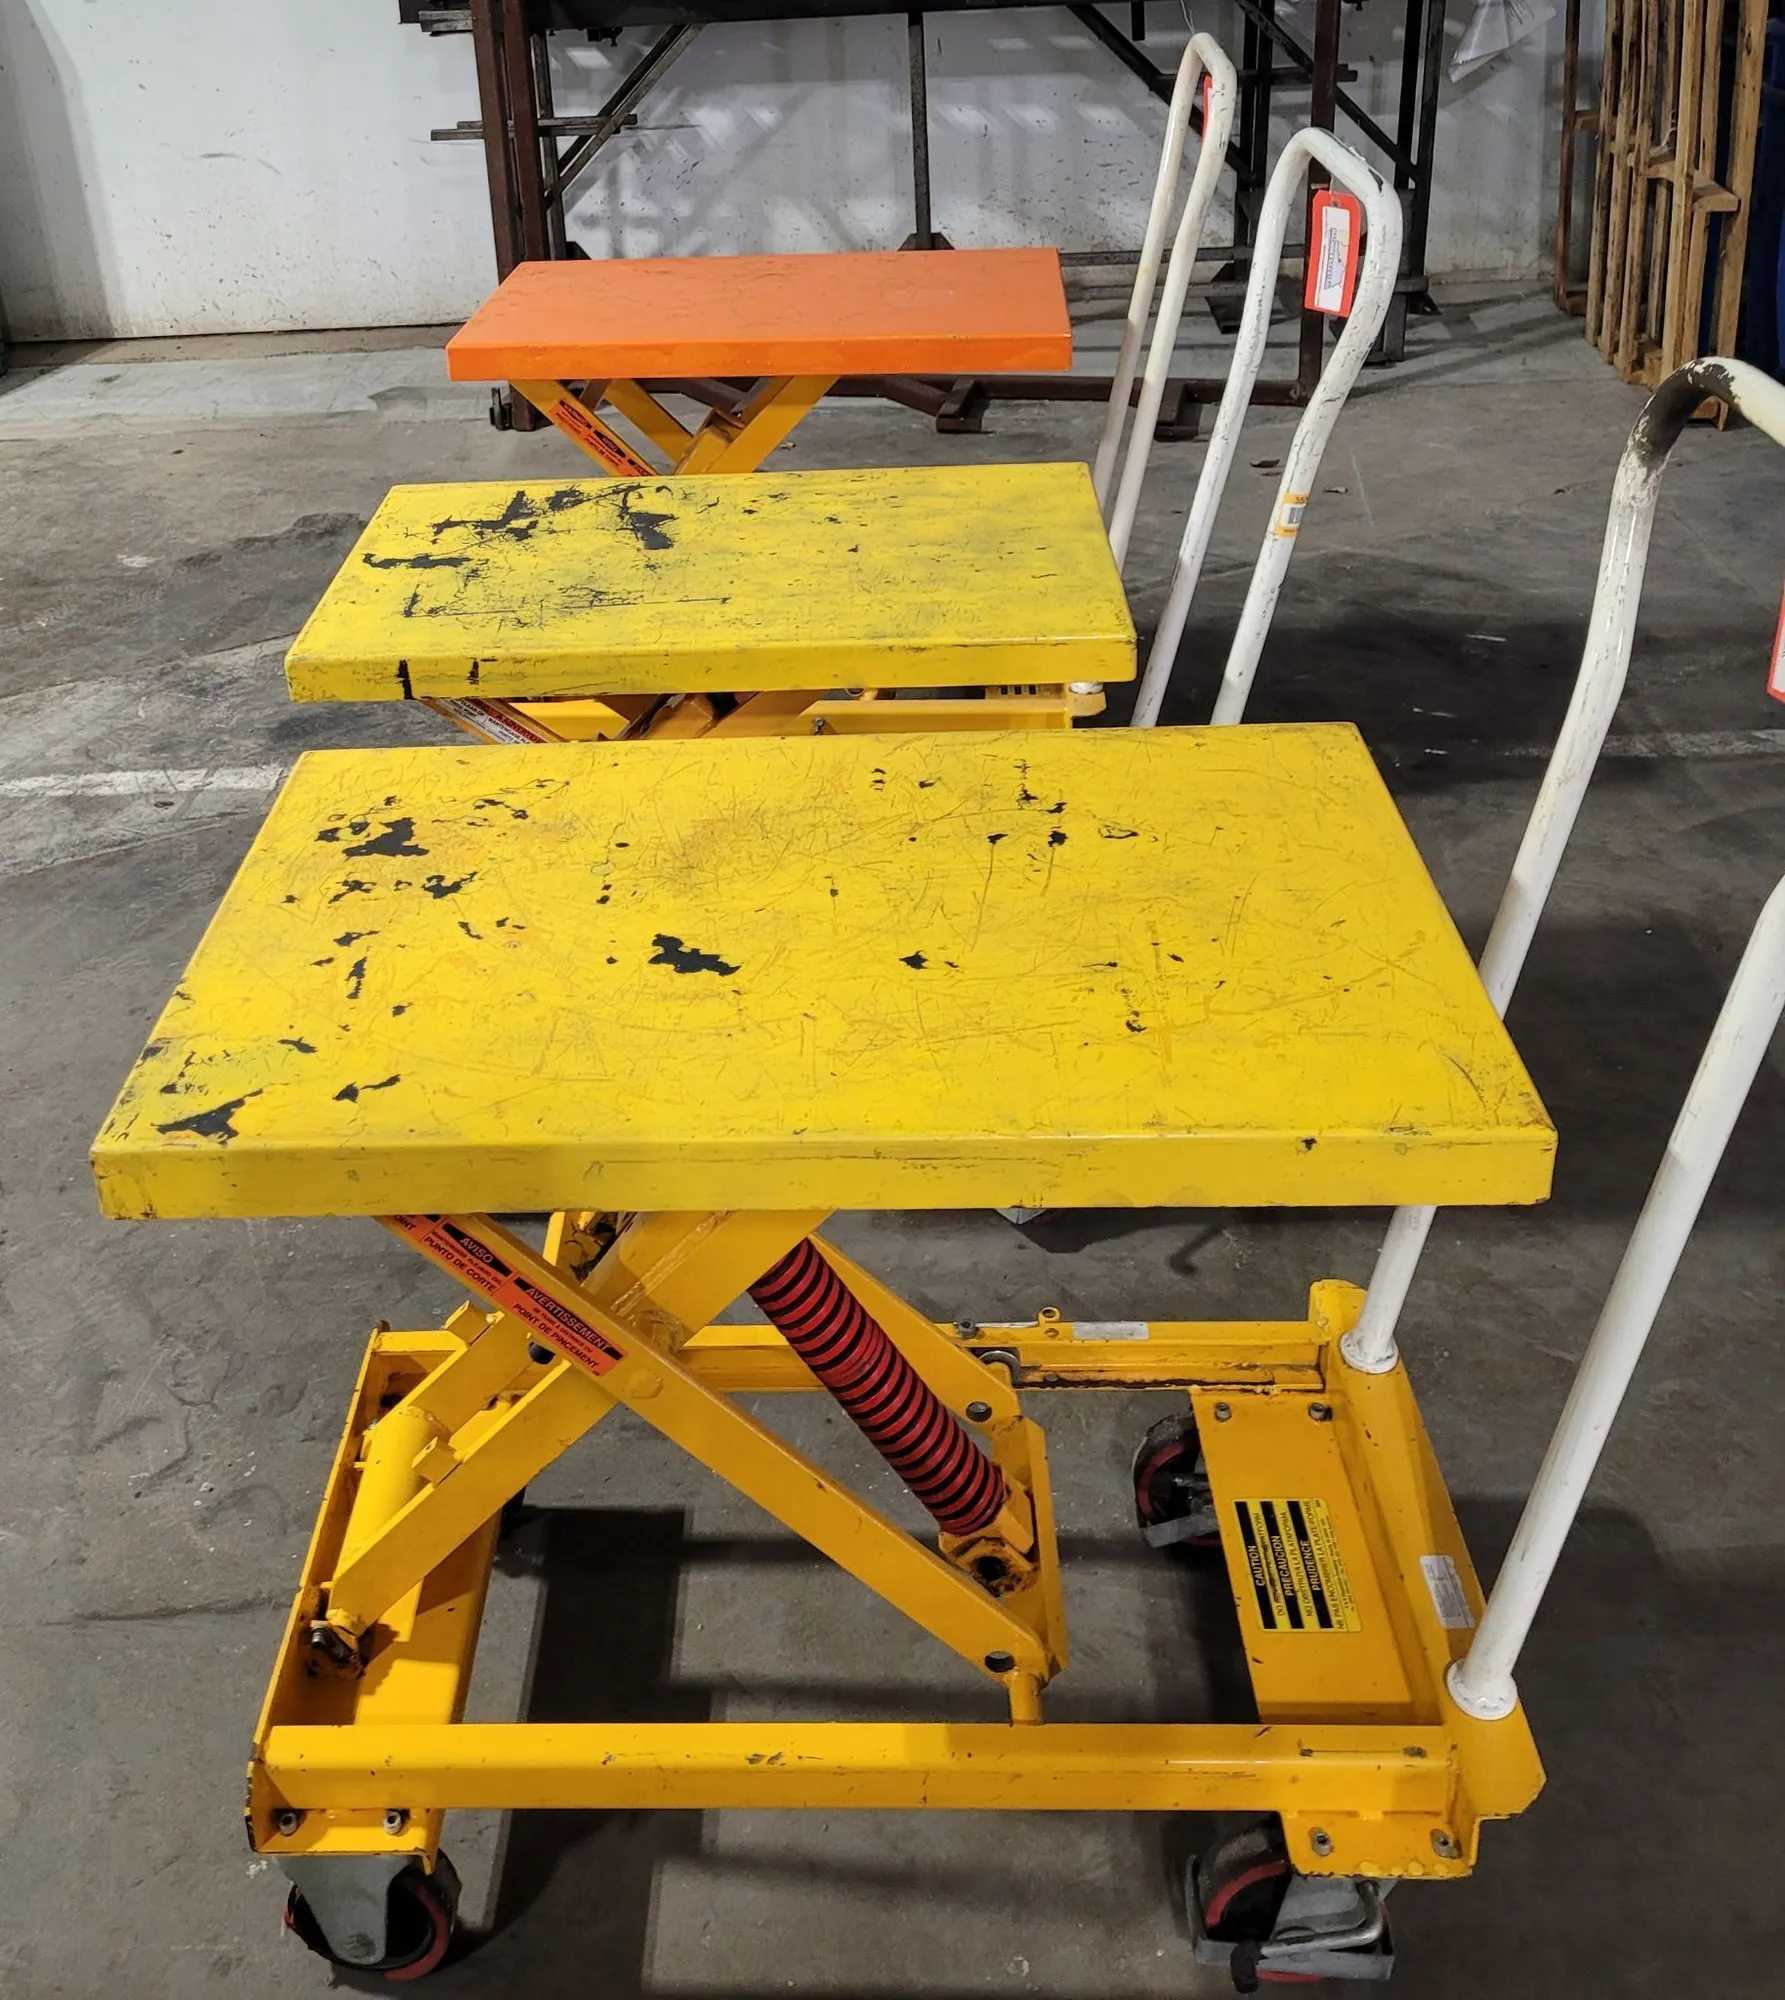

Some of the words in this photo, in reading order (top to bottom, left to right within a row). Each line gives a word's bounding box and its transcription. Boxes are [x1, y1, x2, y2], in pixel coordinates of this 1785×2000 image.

[424, 1236, 454, 1260] PUNTO
[453, 1259, 466, 1270] DE
[466, 1268, 498, 1293] CORTE
[460, 1238, 494, 1264] AVISO
[512, 1303, 538, 1325] POINT
[538, 1322, 553, 1334] DE
[551, 1332, 600, 1370] PINCEMENT
[526, 1287, 610, 1350] AVERTISSEMENT
[1247, 1545, 1266, 1587] CAUTION
[1270, 1535, 1296, 1597] PRECAUCION
[1300, 1539, 1322, 1591] PRUDENCE
